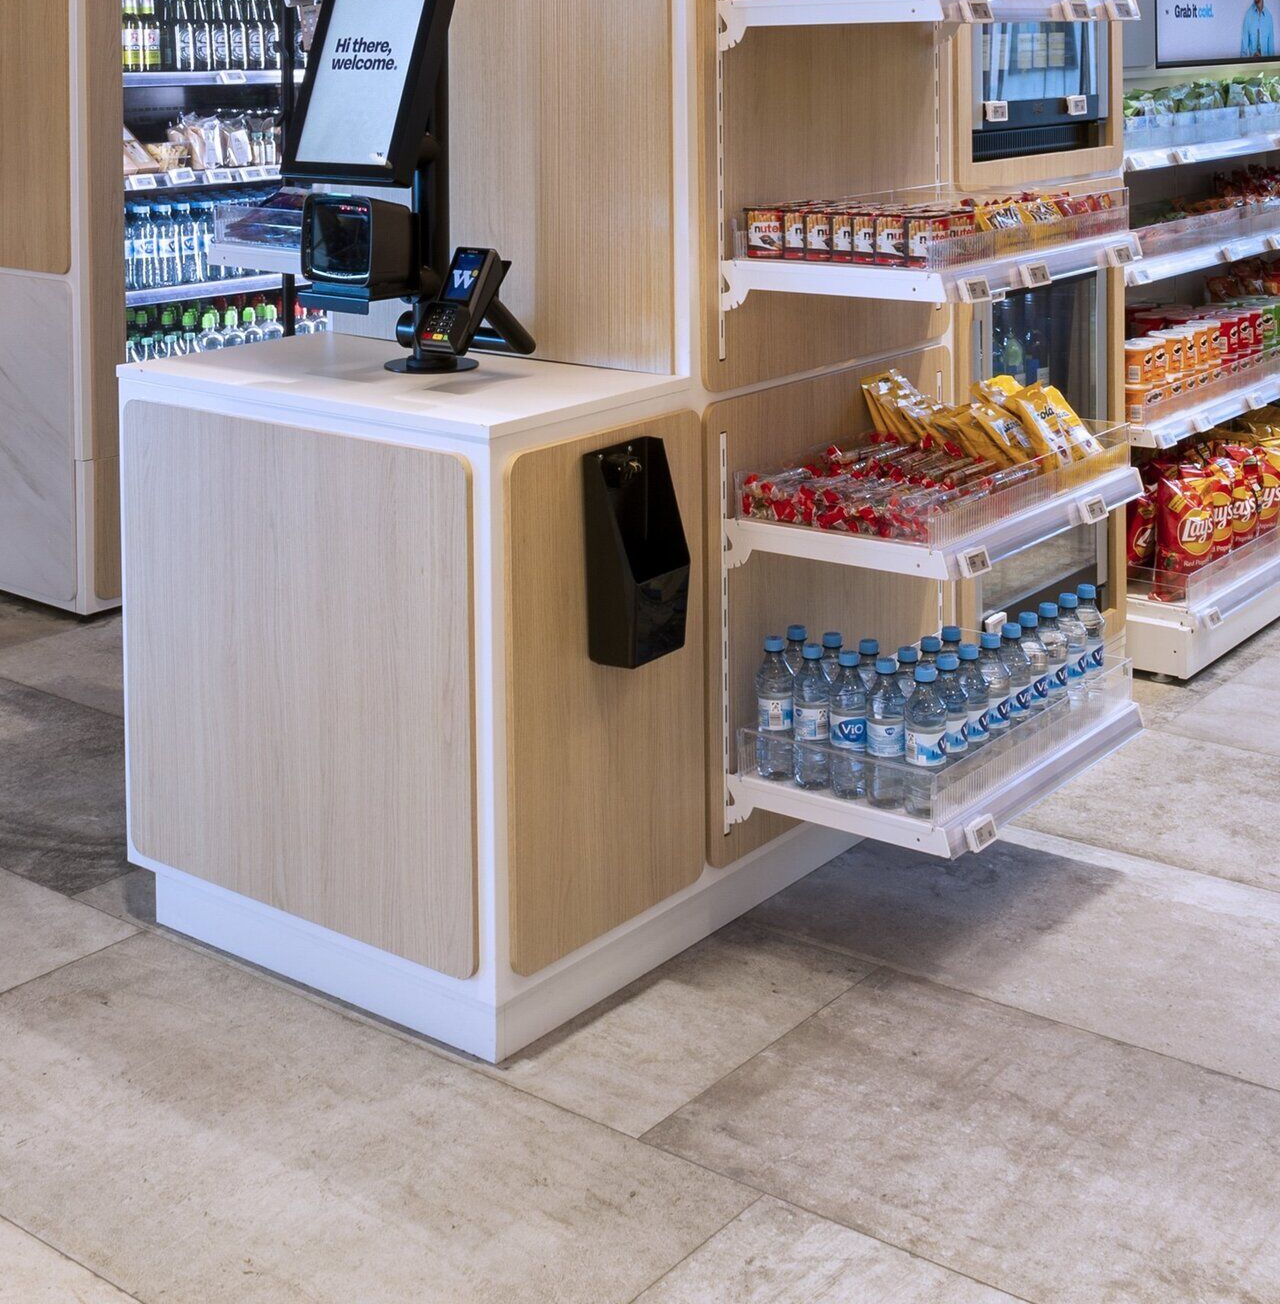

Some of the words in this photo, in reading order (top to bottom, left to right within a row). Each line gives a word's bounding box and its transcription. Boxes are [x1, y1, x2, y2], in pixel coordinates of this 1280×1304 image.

[1174, 3, 1192, 18] Grab
[1192, 3, 1198, 18] it
[335, 36, 352, 53] Hi
[352, 36, 392, 56] there,
[331, 54, 398, 71] welcome.
[452, 269, 475, 289] W
[1181, 516, 1214, 544] Lay's
